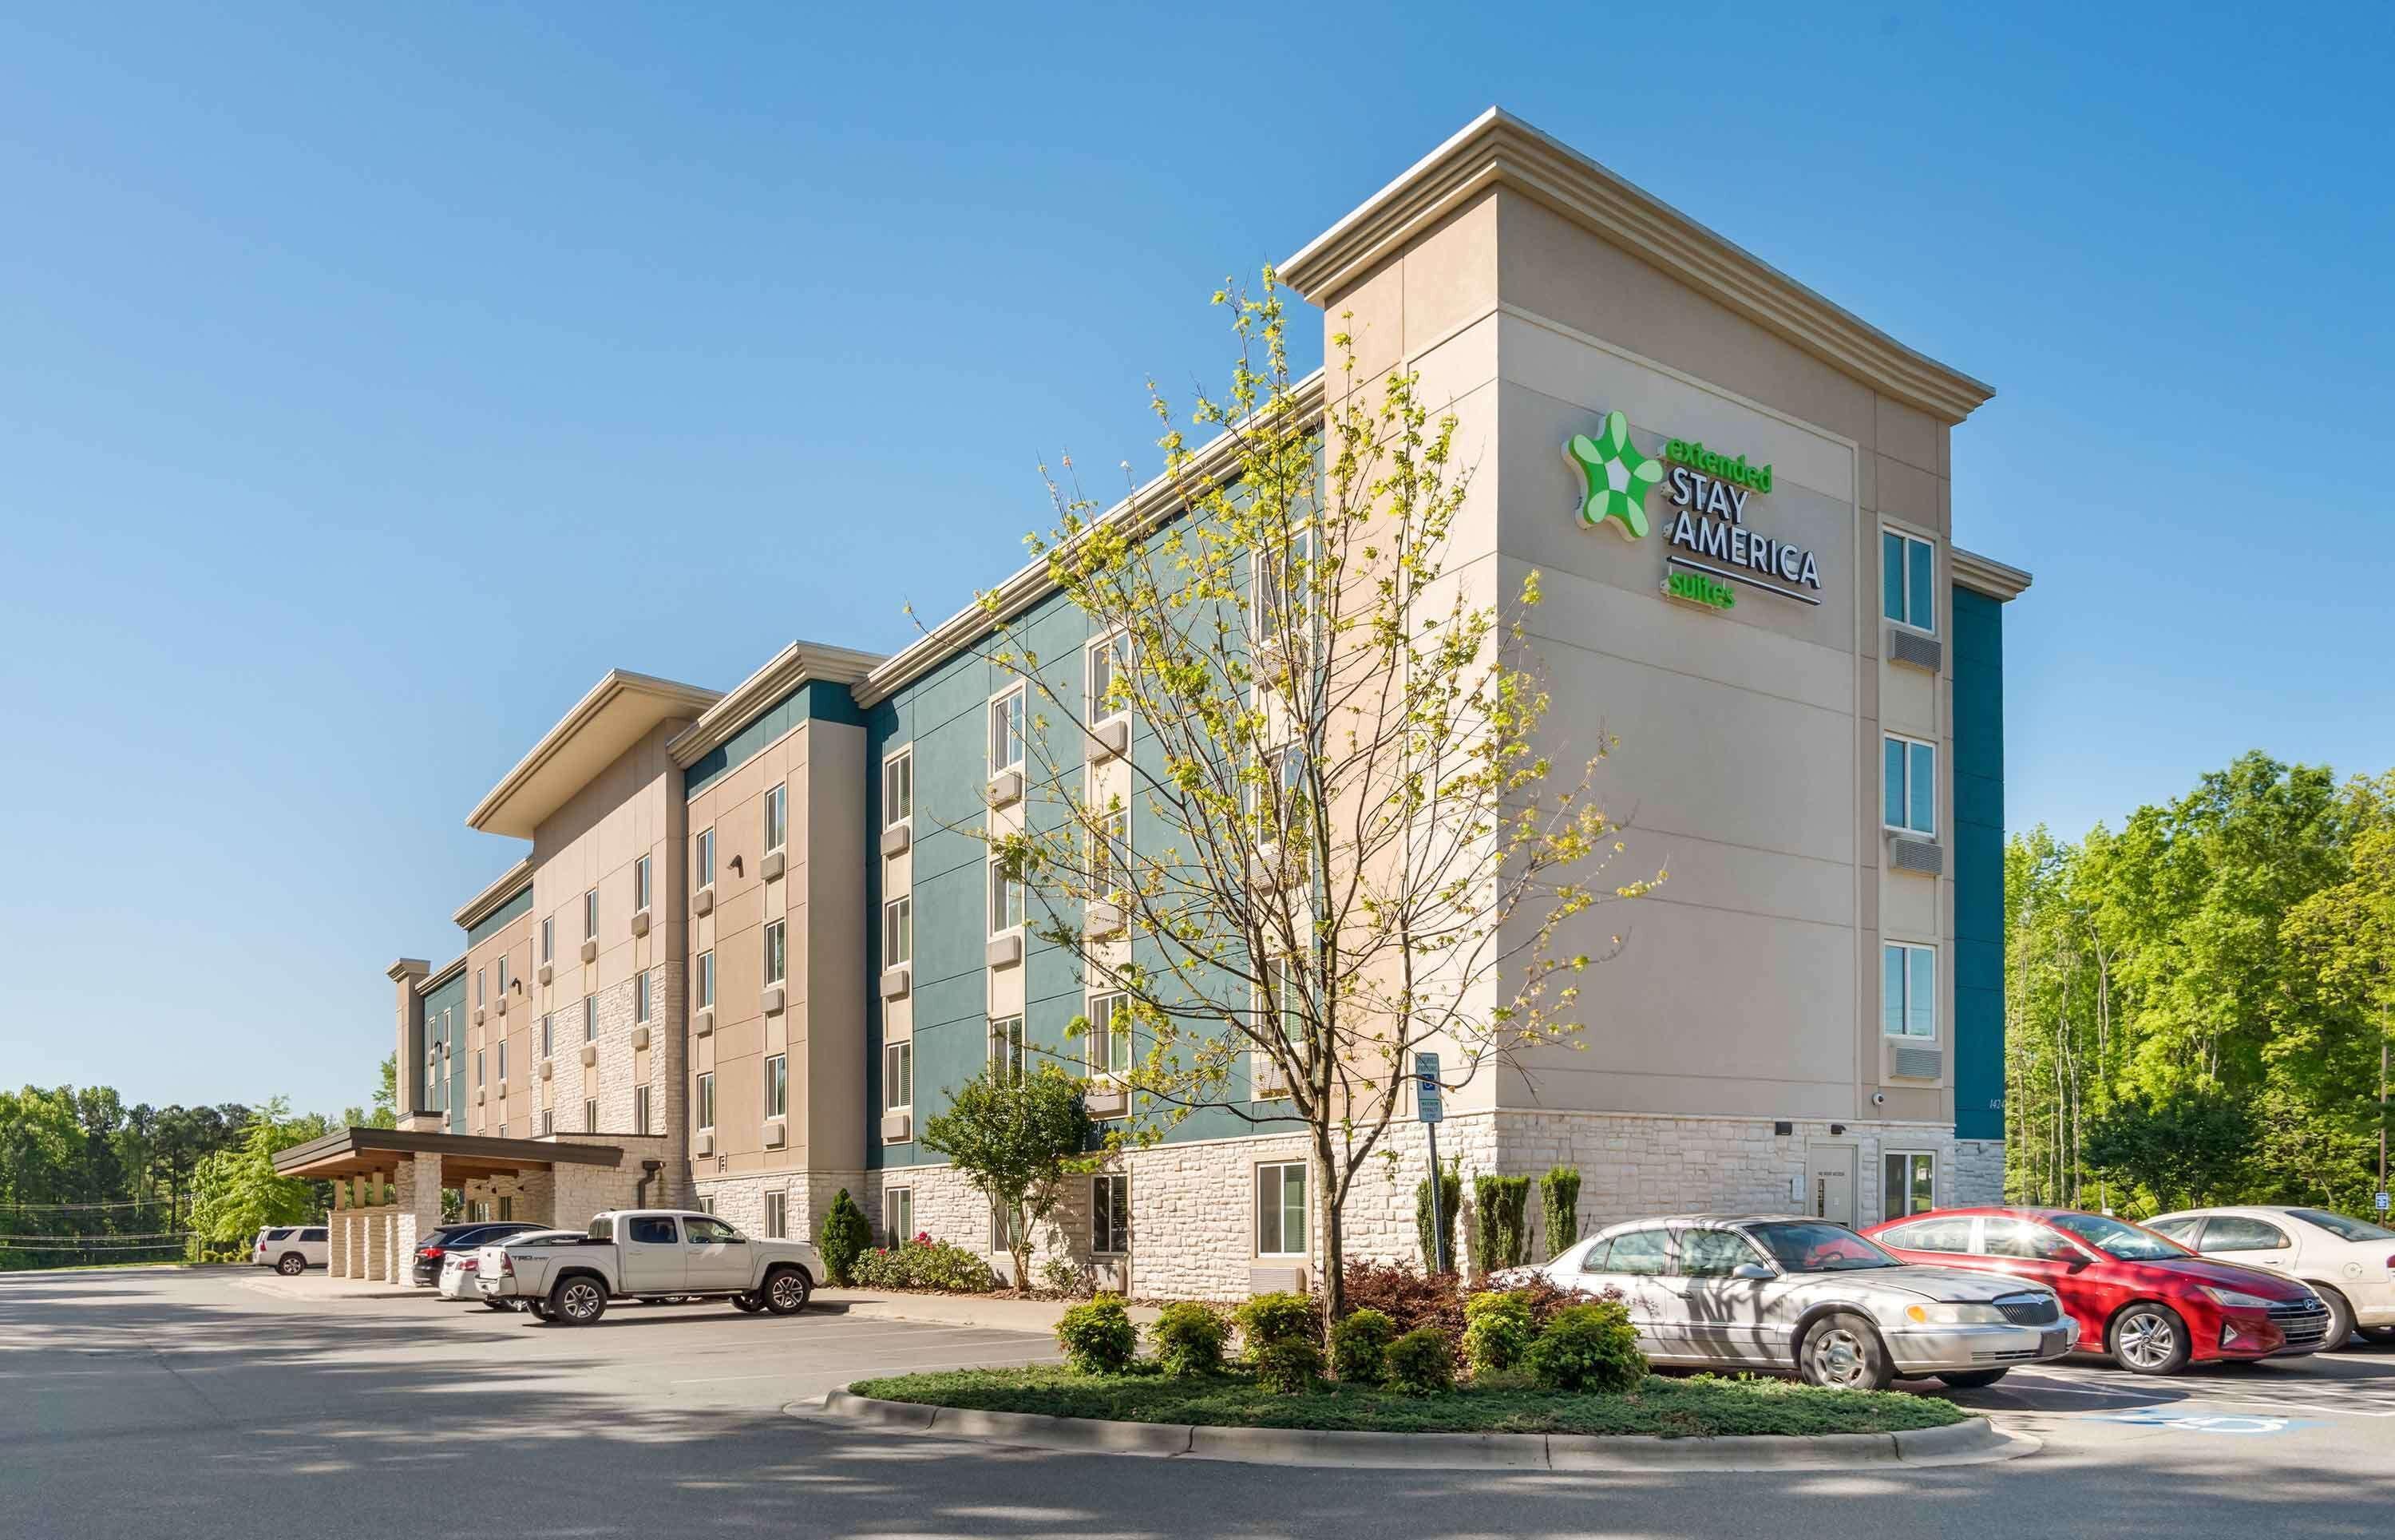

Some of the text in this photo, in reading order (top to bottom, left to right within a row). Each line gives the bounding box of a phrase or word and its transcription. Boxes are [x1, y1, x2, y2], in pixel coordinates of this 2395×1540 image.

[1666, 439, 1772, 493] extended
[1669, 466, 1749, 525] STAY
[1670, 510, 1821, 589] AMERICA
[1669, 572, 1736, 609] suites
